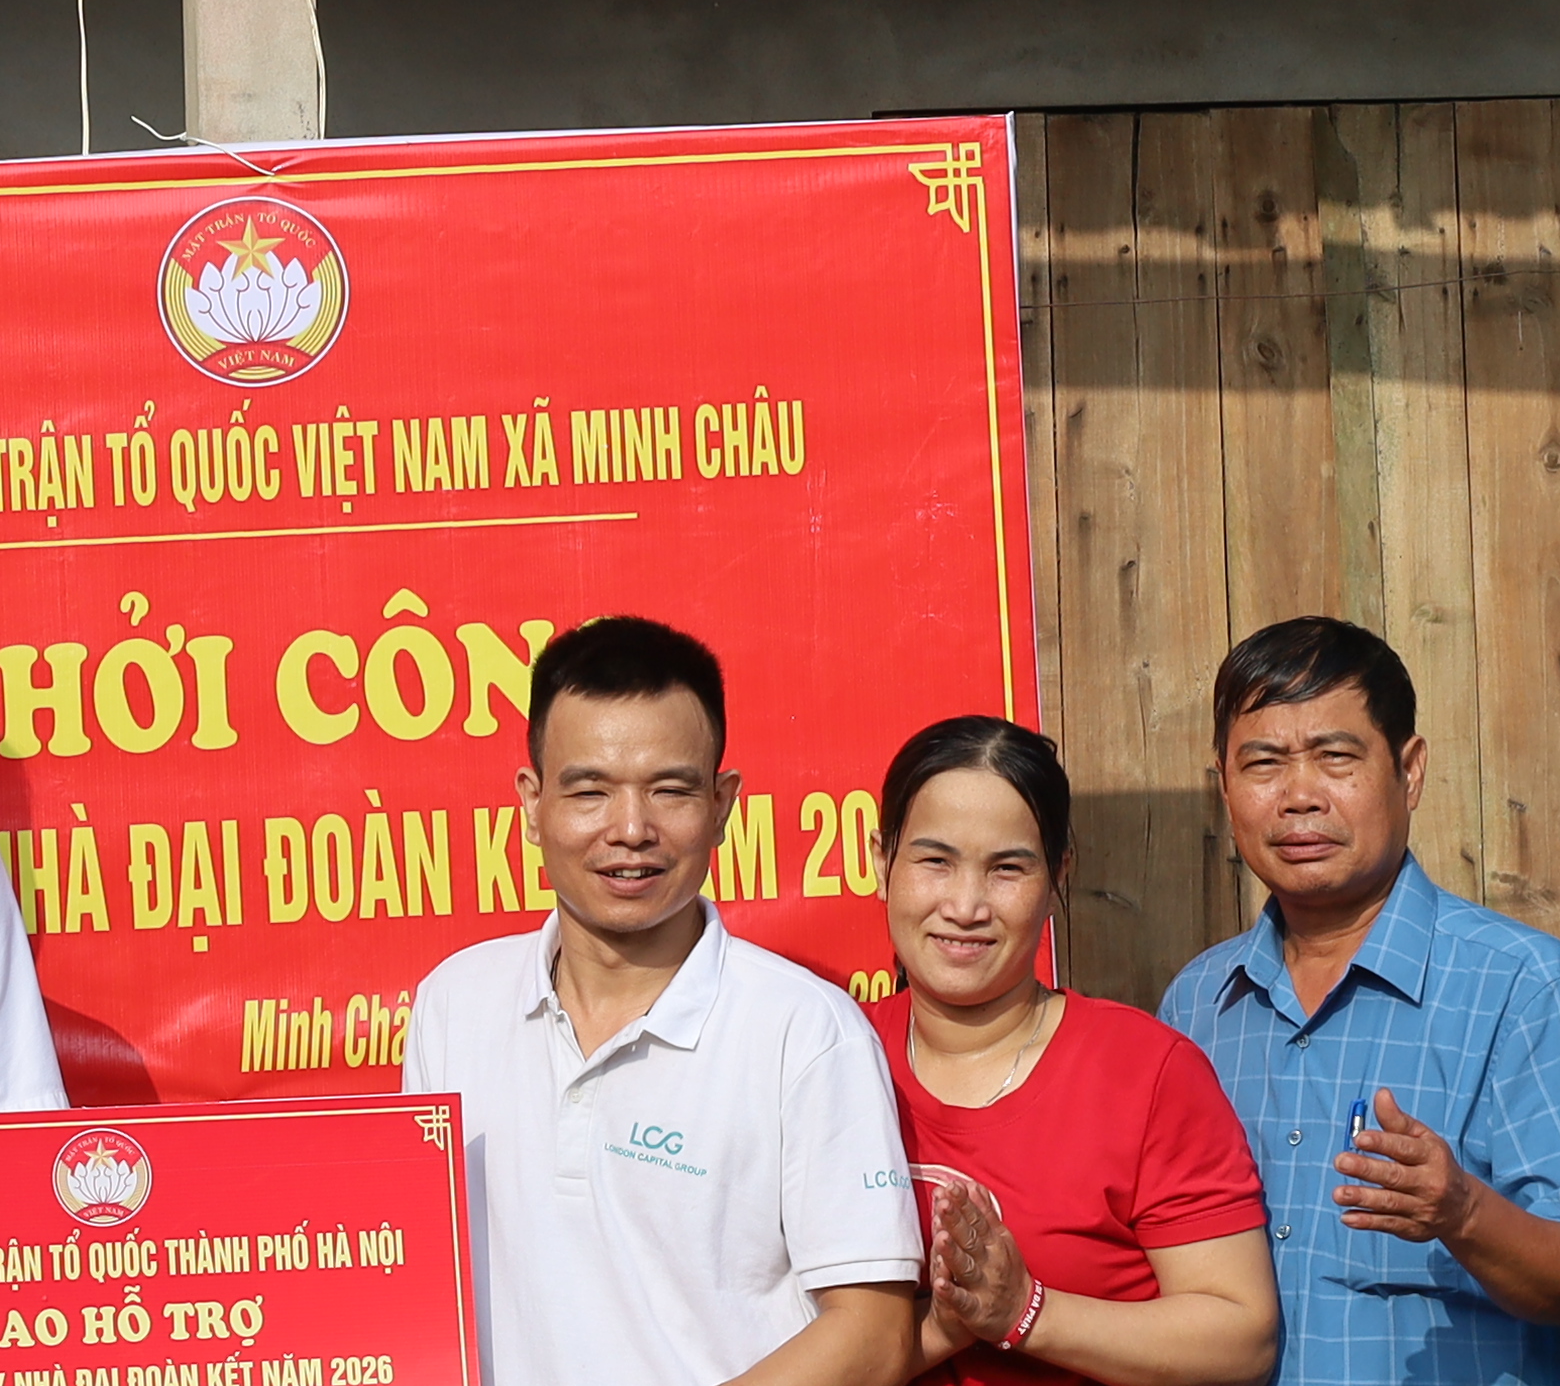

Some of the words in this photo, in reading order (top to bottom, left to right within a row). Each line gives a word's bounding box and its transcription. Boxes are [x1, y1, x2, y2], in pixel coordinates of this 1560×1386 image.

[105, 399, 157, 507] TỔ
[170, 398, 281, 513] QUỐC
[291, 405, 379, 514] VIỆT
[392, 415, 490, 493] NAM
[501, 396, 560, 488] XÃ
[570, 406, 682, 485] MINH
[694, 385, 805, 479] CHÂU
[276, 588, 556, 745] CÔN
[128, 819, 243, 953] ĐẠI
[263, 788, 453, 924] ĐOÀN
[241, 996, 333, 1073] Minh
[344, 990, 412, 1069] Châ
[603, 1142, 636, 1160] LONDON
[637, 1153, 673, 1169] CAPITAL
[674, 1162, 708, 1177] GROUP
[629, 1121, 684, 1155] LCG
[48, 1228, 81, 1281] TỔ
[88, 1227, 158, 1283] QUỐC
[163, 1229, 250, 1276] THÀNH
[256, 1220, 310, 1272] PHỐ
[316, 1223, 353, 1269] HÀ
[358, 1221, 405, 1275] NỘI
[81, 1284, 151, 1345] HỖ
[162, 1294, 264, 1347] TRỢ
[330, 1354, 394, 1386] 2026
